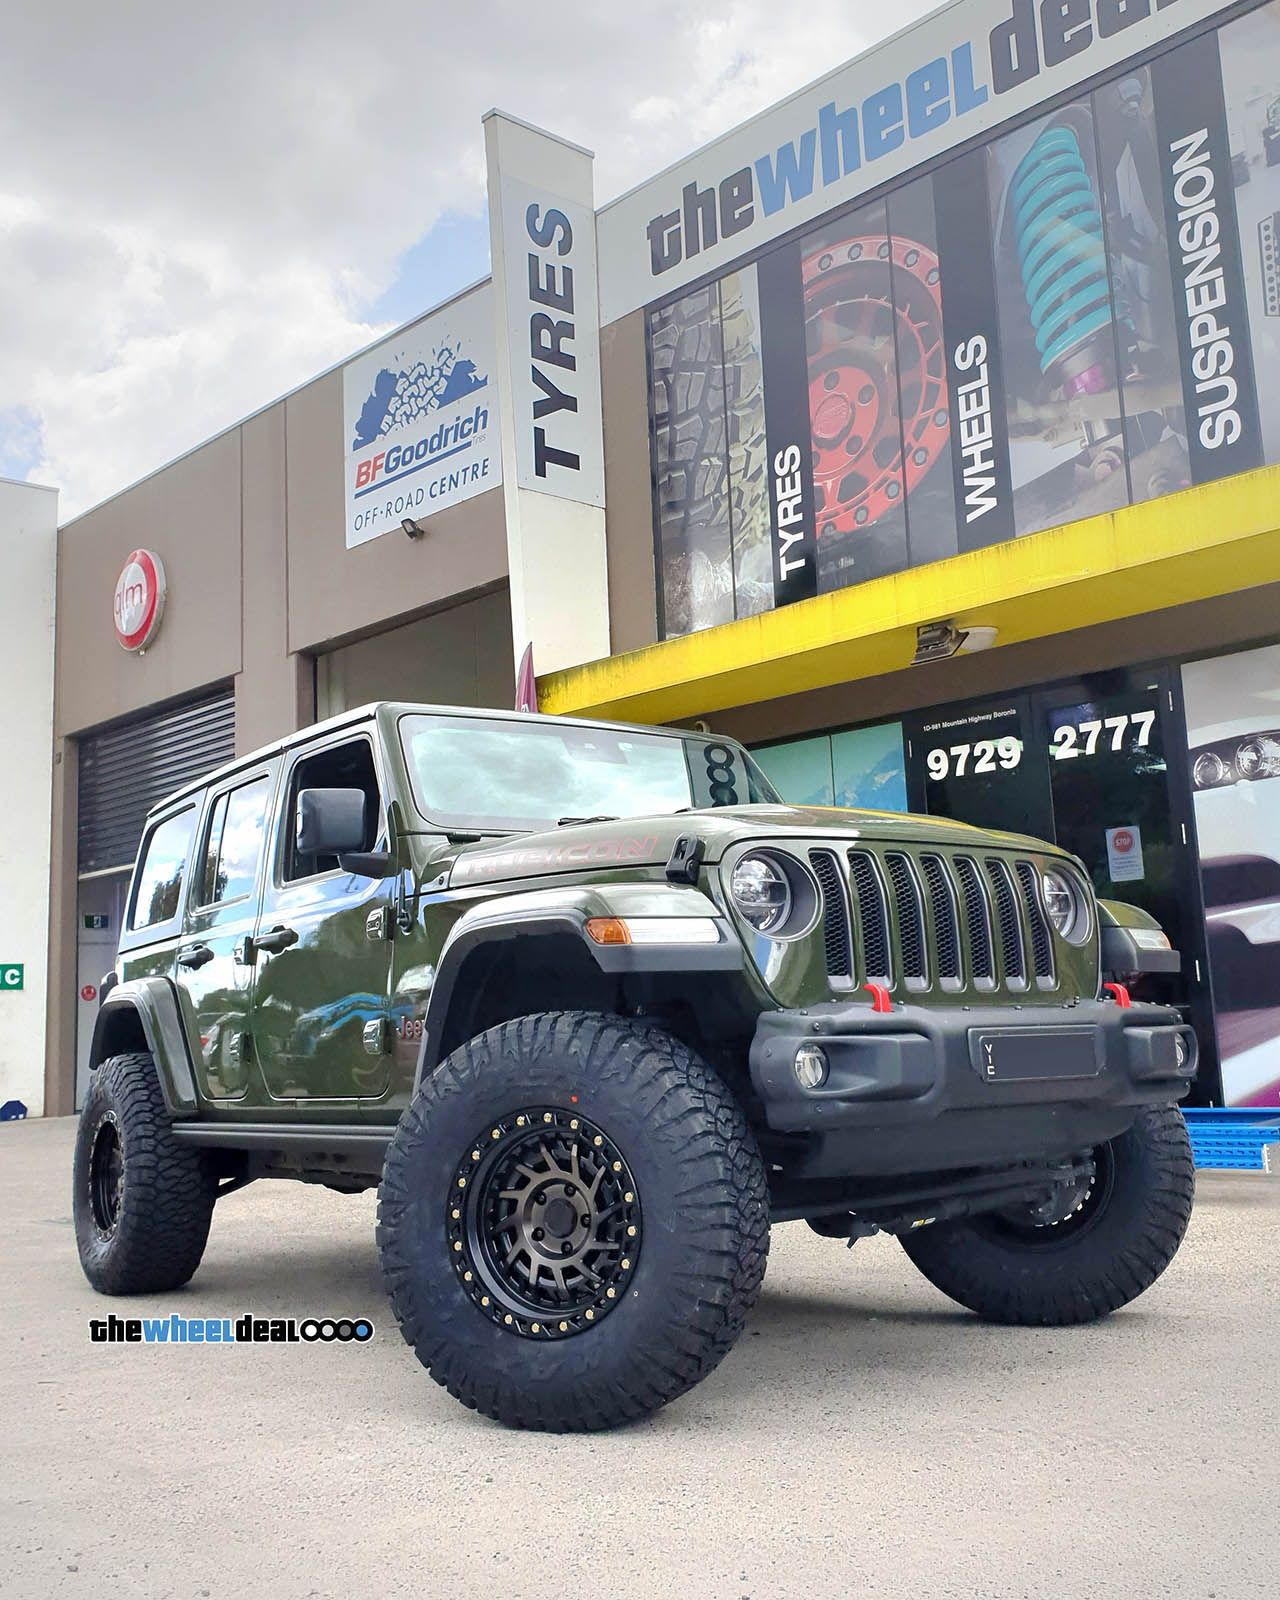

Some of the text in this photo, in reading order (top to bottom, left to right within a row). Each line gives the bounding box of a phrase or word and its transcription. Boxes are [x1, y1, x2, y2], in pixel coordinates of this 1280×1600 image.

[1170, 128, 1242, 449] SUSPENSION
[526, 203, 580, 478] TYRES
[355, 406, 489, 489] BFGoodrich
[954, 334, 998, 523] WHEELS
[429, 457, 490, 498] CENTRE
[774, 444, 805, 581] TYRES
[927, 710, 1155, 781] 9729 2777
[942, 718, 967, 728] Mountain
[968, 713, 992, 723] Highway
[993, 708, 1016, 718] Boronia
[396, 1016, 425, 1040] Jee
